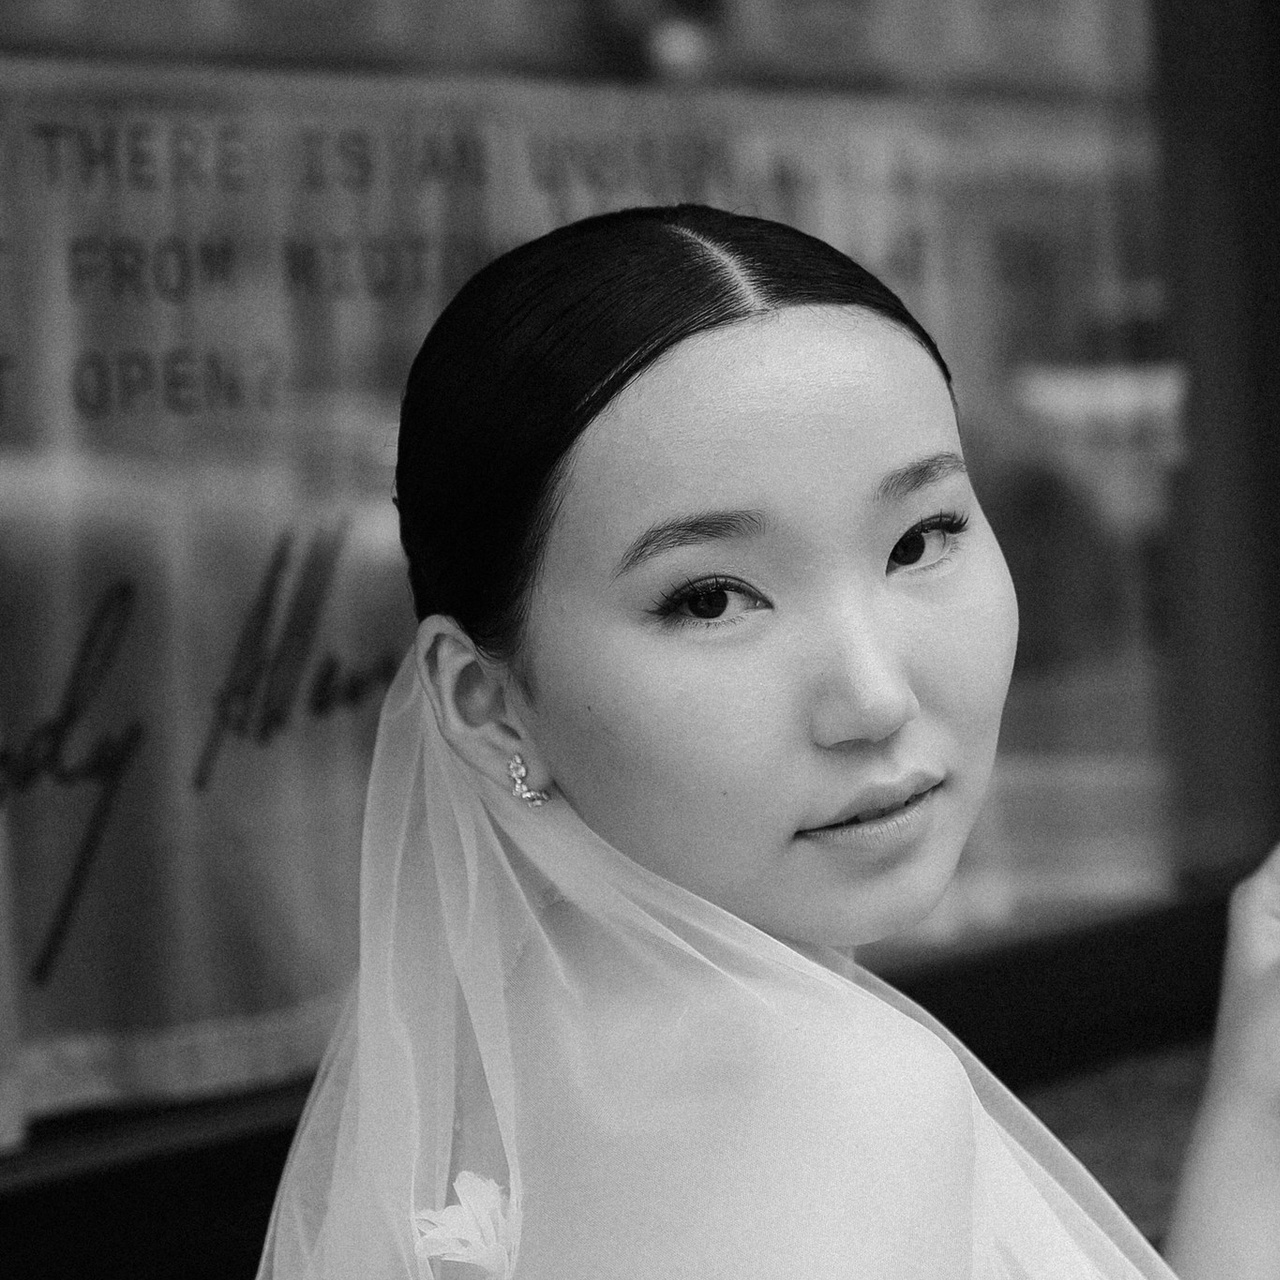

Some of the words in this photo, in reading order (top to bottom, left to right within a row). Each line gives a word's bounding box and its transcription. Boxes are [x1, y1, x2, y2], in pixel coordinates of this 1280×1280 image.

[32, 122, 246, 194] THERE
[300, 128, 376, 196] IS
[68, 236, 236, 306] FROM
